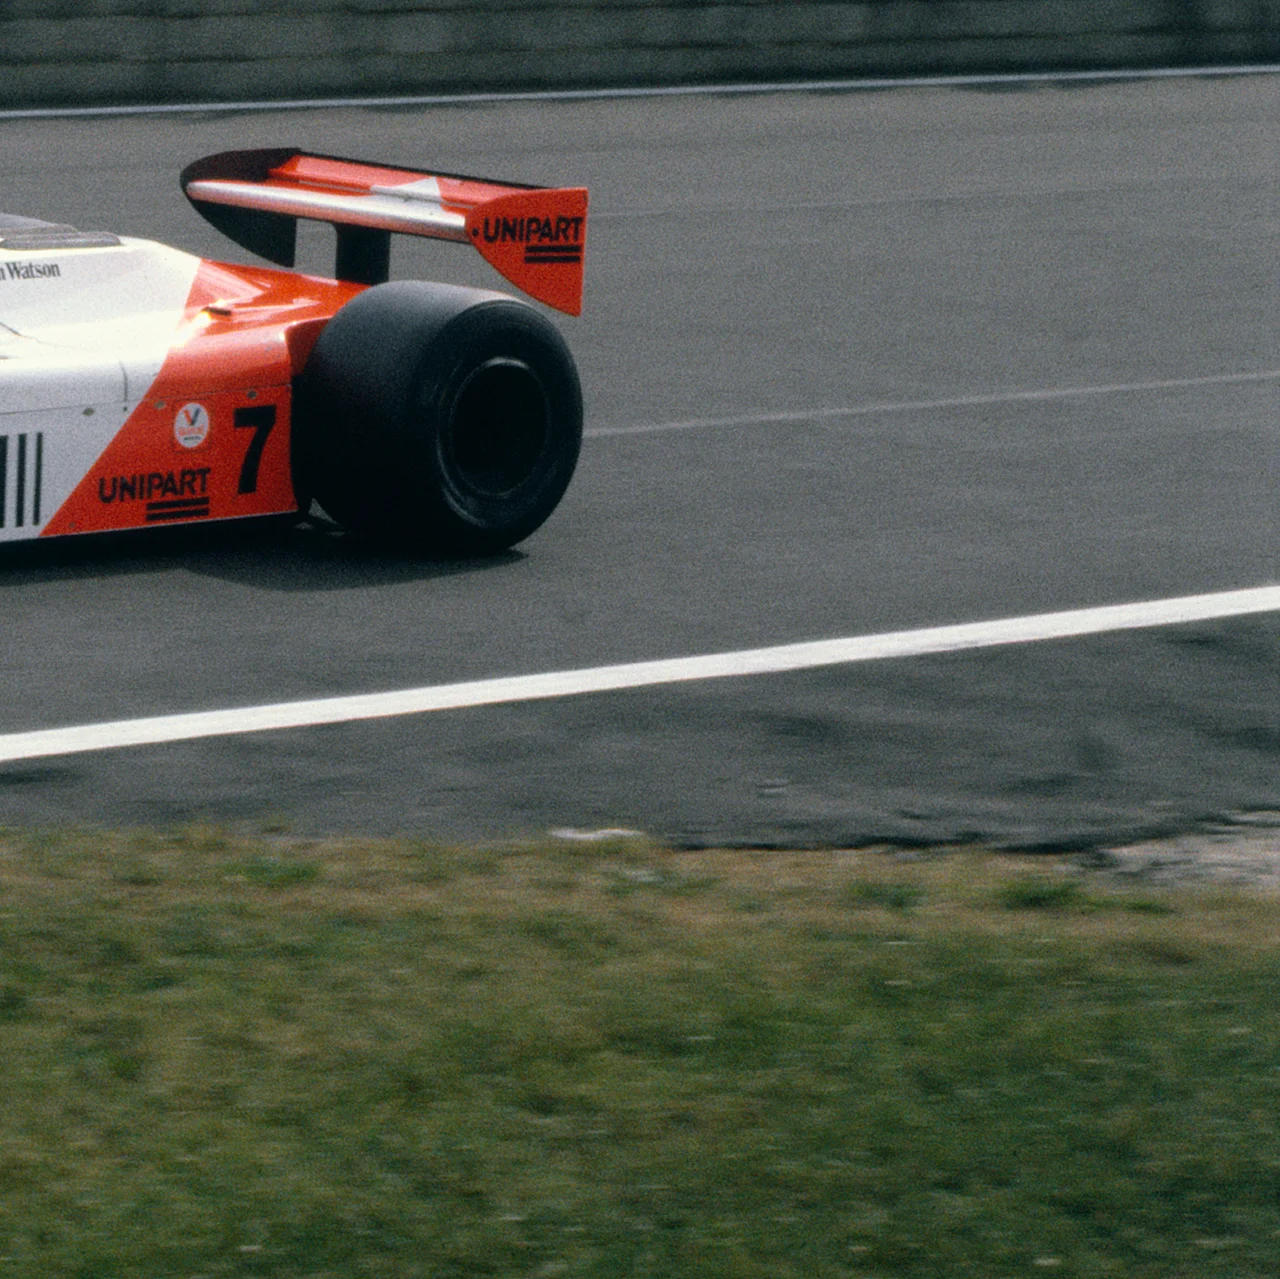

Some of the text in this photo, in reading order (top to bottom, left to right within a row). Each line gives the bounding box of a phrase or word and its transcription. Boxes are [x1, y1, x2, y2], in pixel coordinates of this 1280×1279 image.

[483, 216, 583, 243] UNIPART
[5, 261, 61, 281] Watson
[233, 405, 276, 495] 7
[99, 468, 211, 504] UNIPART
